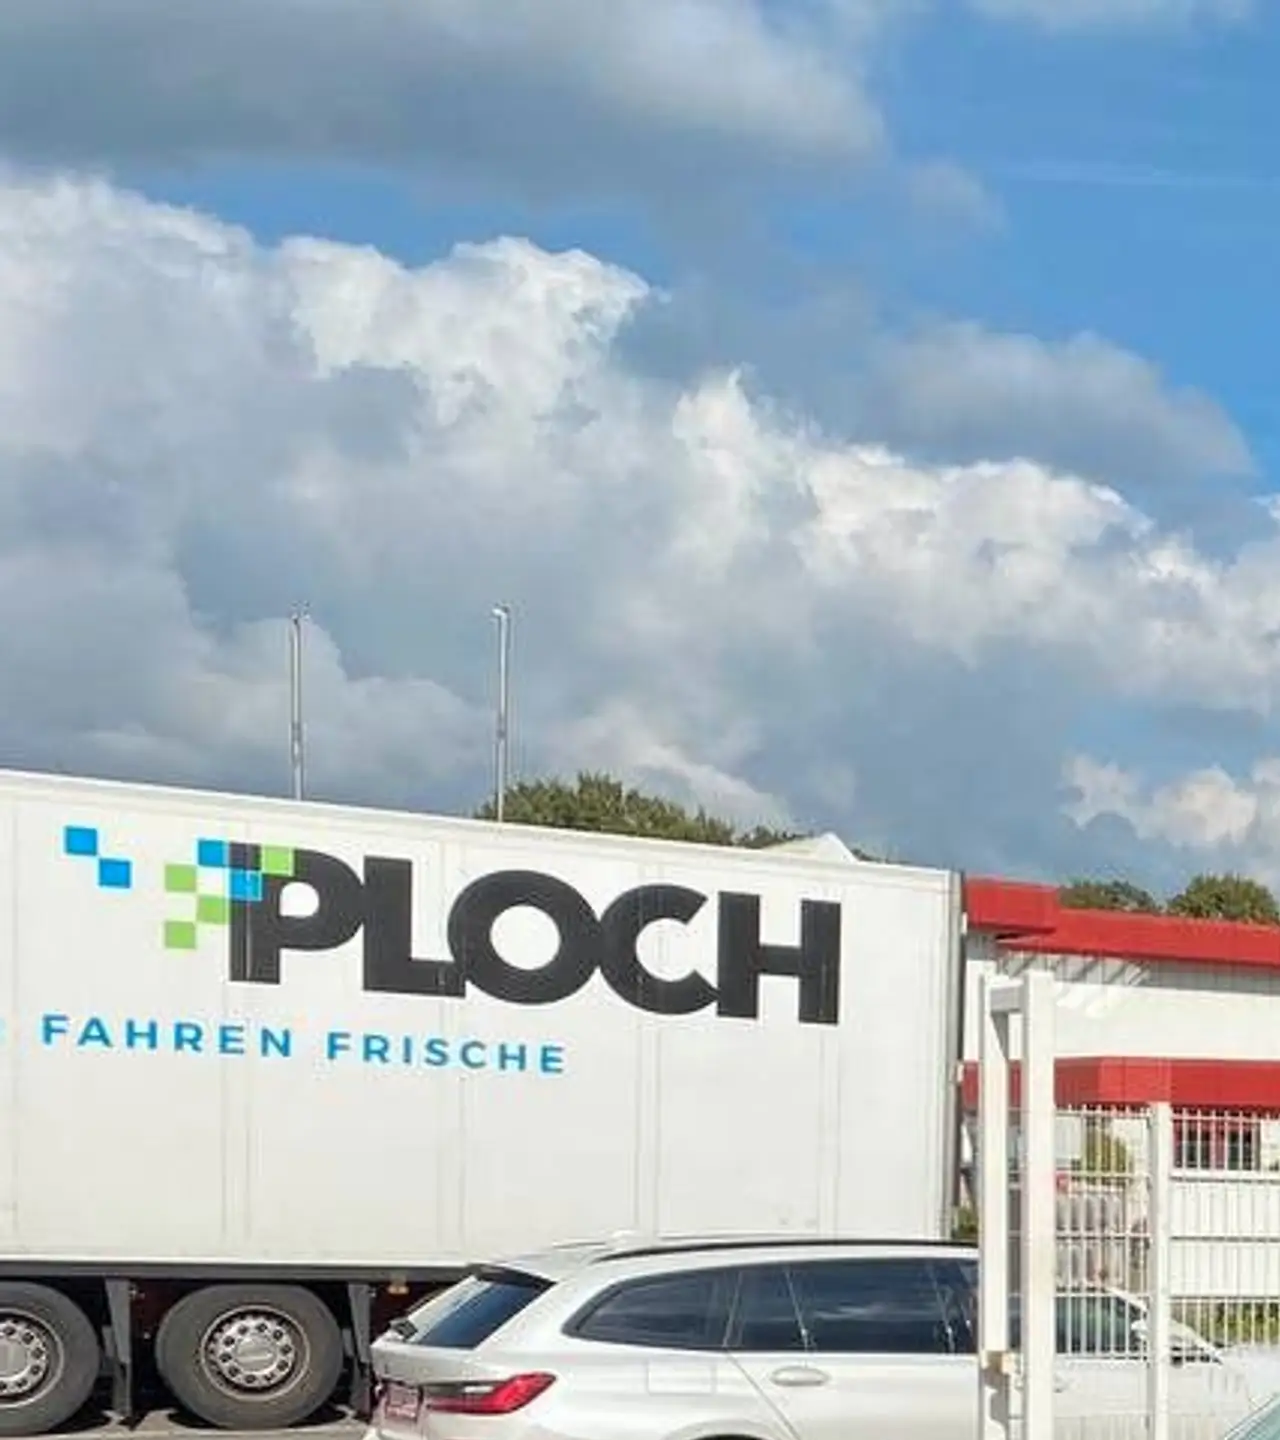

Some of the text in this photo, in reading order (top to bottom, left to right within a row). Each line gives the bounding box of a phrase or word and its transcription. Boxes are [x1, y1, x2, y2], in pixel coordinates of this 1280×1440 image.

[229, 842, 841, 1025] PLOCH
[42, 1013, 293, 1057] FAHREN
[327, 1032, 566, 1075] FRISCHE
